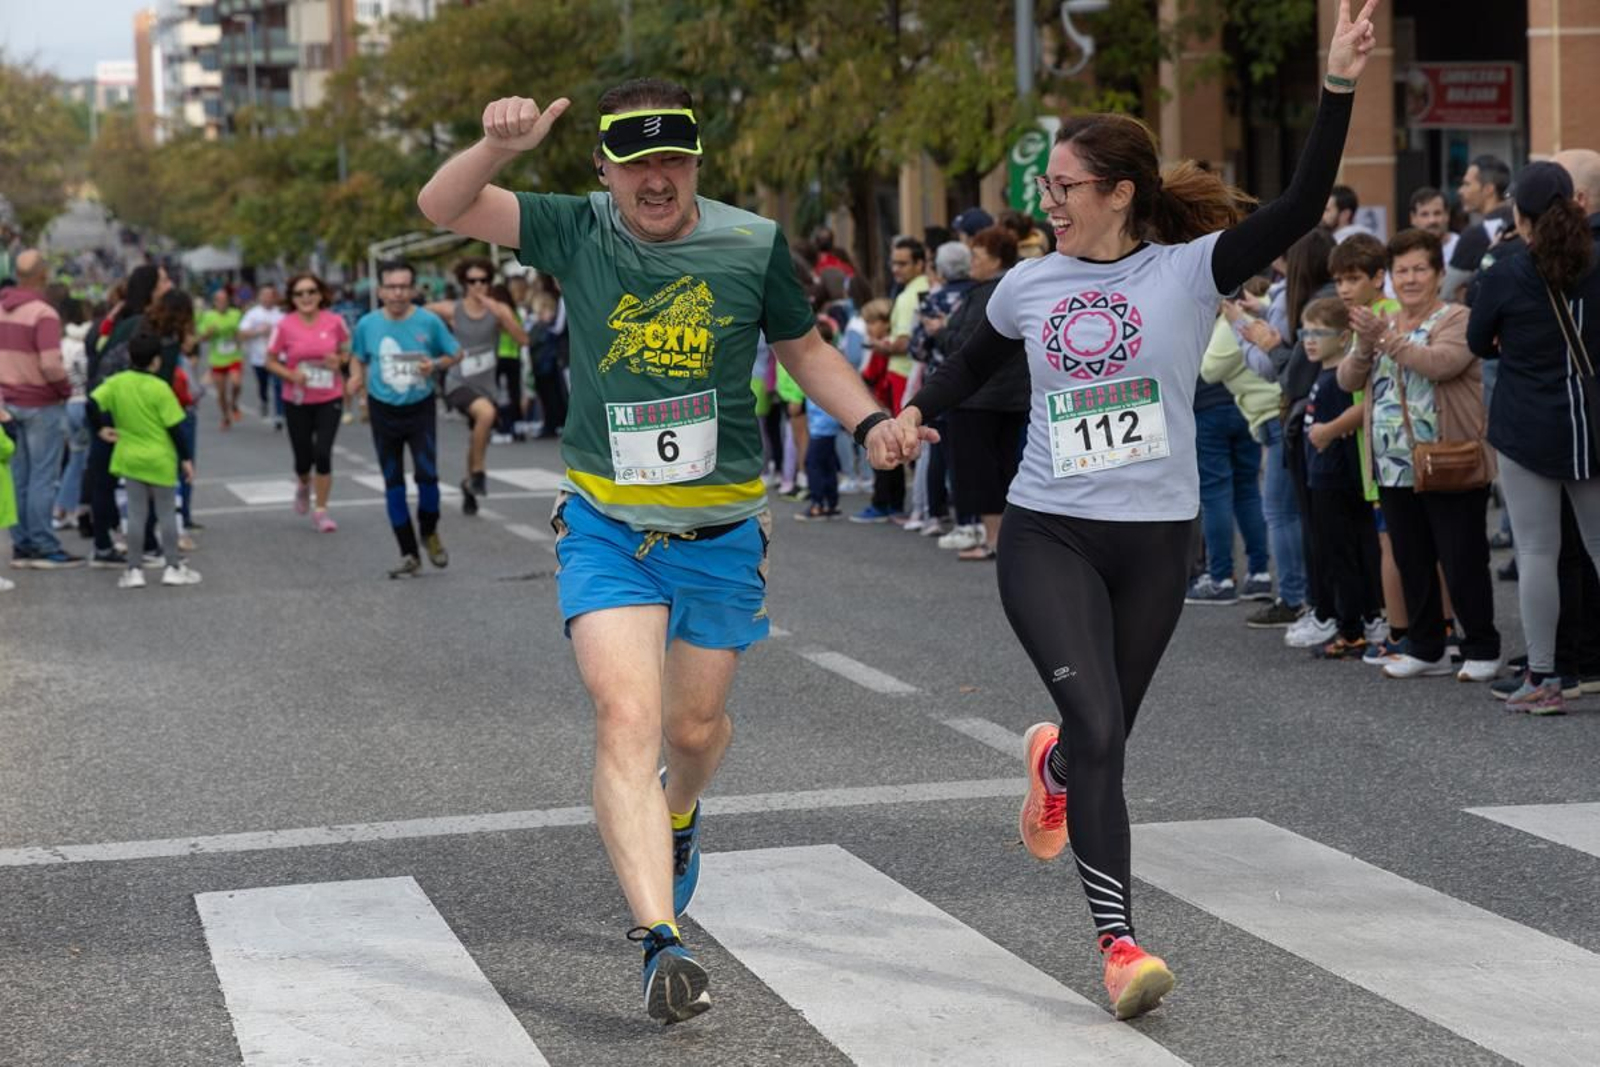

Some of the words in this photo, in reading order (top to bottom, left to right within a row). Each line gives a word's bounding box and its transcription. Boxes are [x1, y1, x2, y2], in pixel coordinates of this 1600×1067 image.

[645, 323, 708, 352] CXM
[657, 430, 679, 462] 6
[1074, 411, 1143, 451] 112
